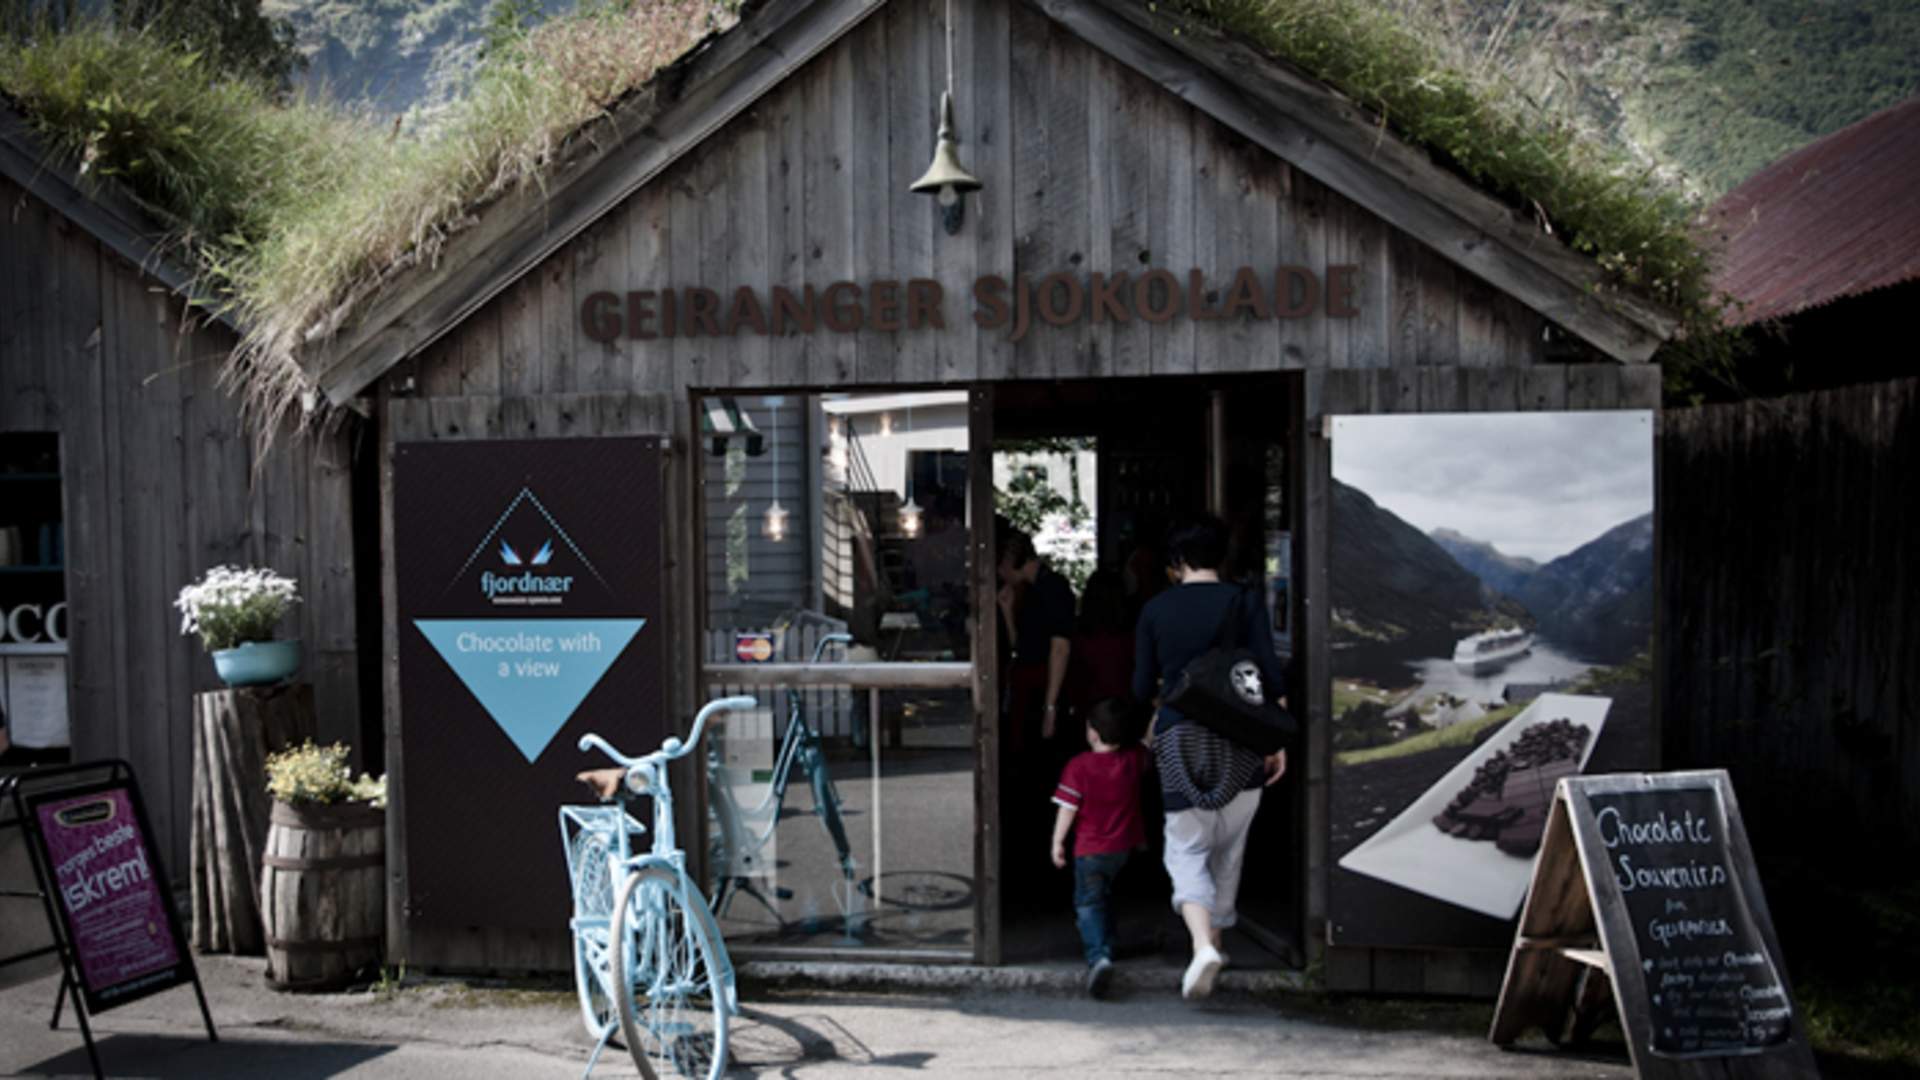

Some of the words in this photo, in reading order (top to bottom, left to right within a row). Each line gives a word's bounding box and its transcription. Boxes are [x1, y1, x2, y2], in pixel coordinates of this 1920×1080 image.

[580, 278, 945, 344] GEIRANGER
[973, 264, 1361, 343] SJOKOLADE
[481, 571, 573, 598] fjordnær
[456, 632, 553, 652] Chocolate
[559, 632, 601, 652] with
[498, 662, 510, 677] a
[516, 658, 560, 677] view
[1596, 806, 1712, 848] Chocolate
[1615, 854, 1726, 891] Souvenirs
